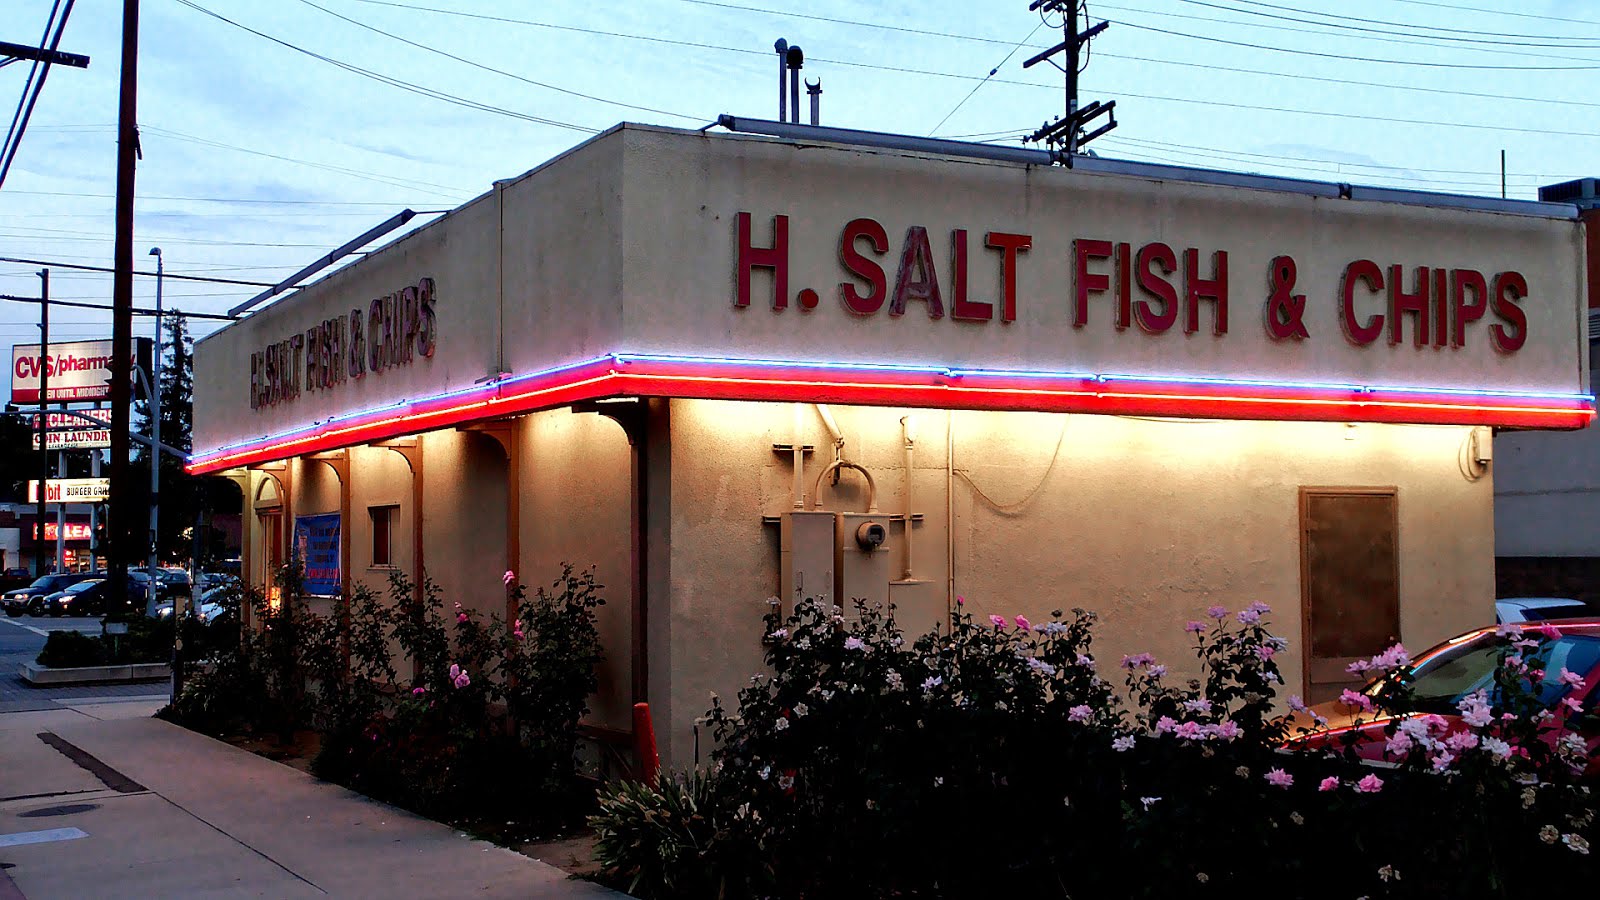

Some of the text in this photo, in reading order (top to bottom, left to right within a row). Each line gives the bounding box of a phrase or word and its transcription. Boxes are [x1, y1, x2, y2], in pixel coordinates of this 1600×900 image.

[734, 211, 1529, 354] H. SALT FISH & CHIPS
[305, 314, 349, 392] FISH
[348, 308, 367, 380] &
[367, 276, 437, 374] CHIPS
[15, 353, 135, 379] CVS/pharma
[56, 388, 75, 399] UNTIL
[35, 430, 111, 444] CIN LAUNDR
[66, 486, 92, 496] BURGER
